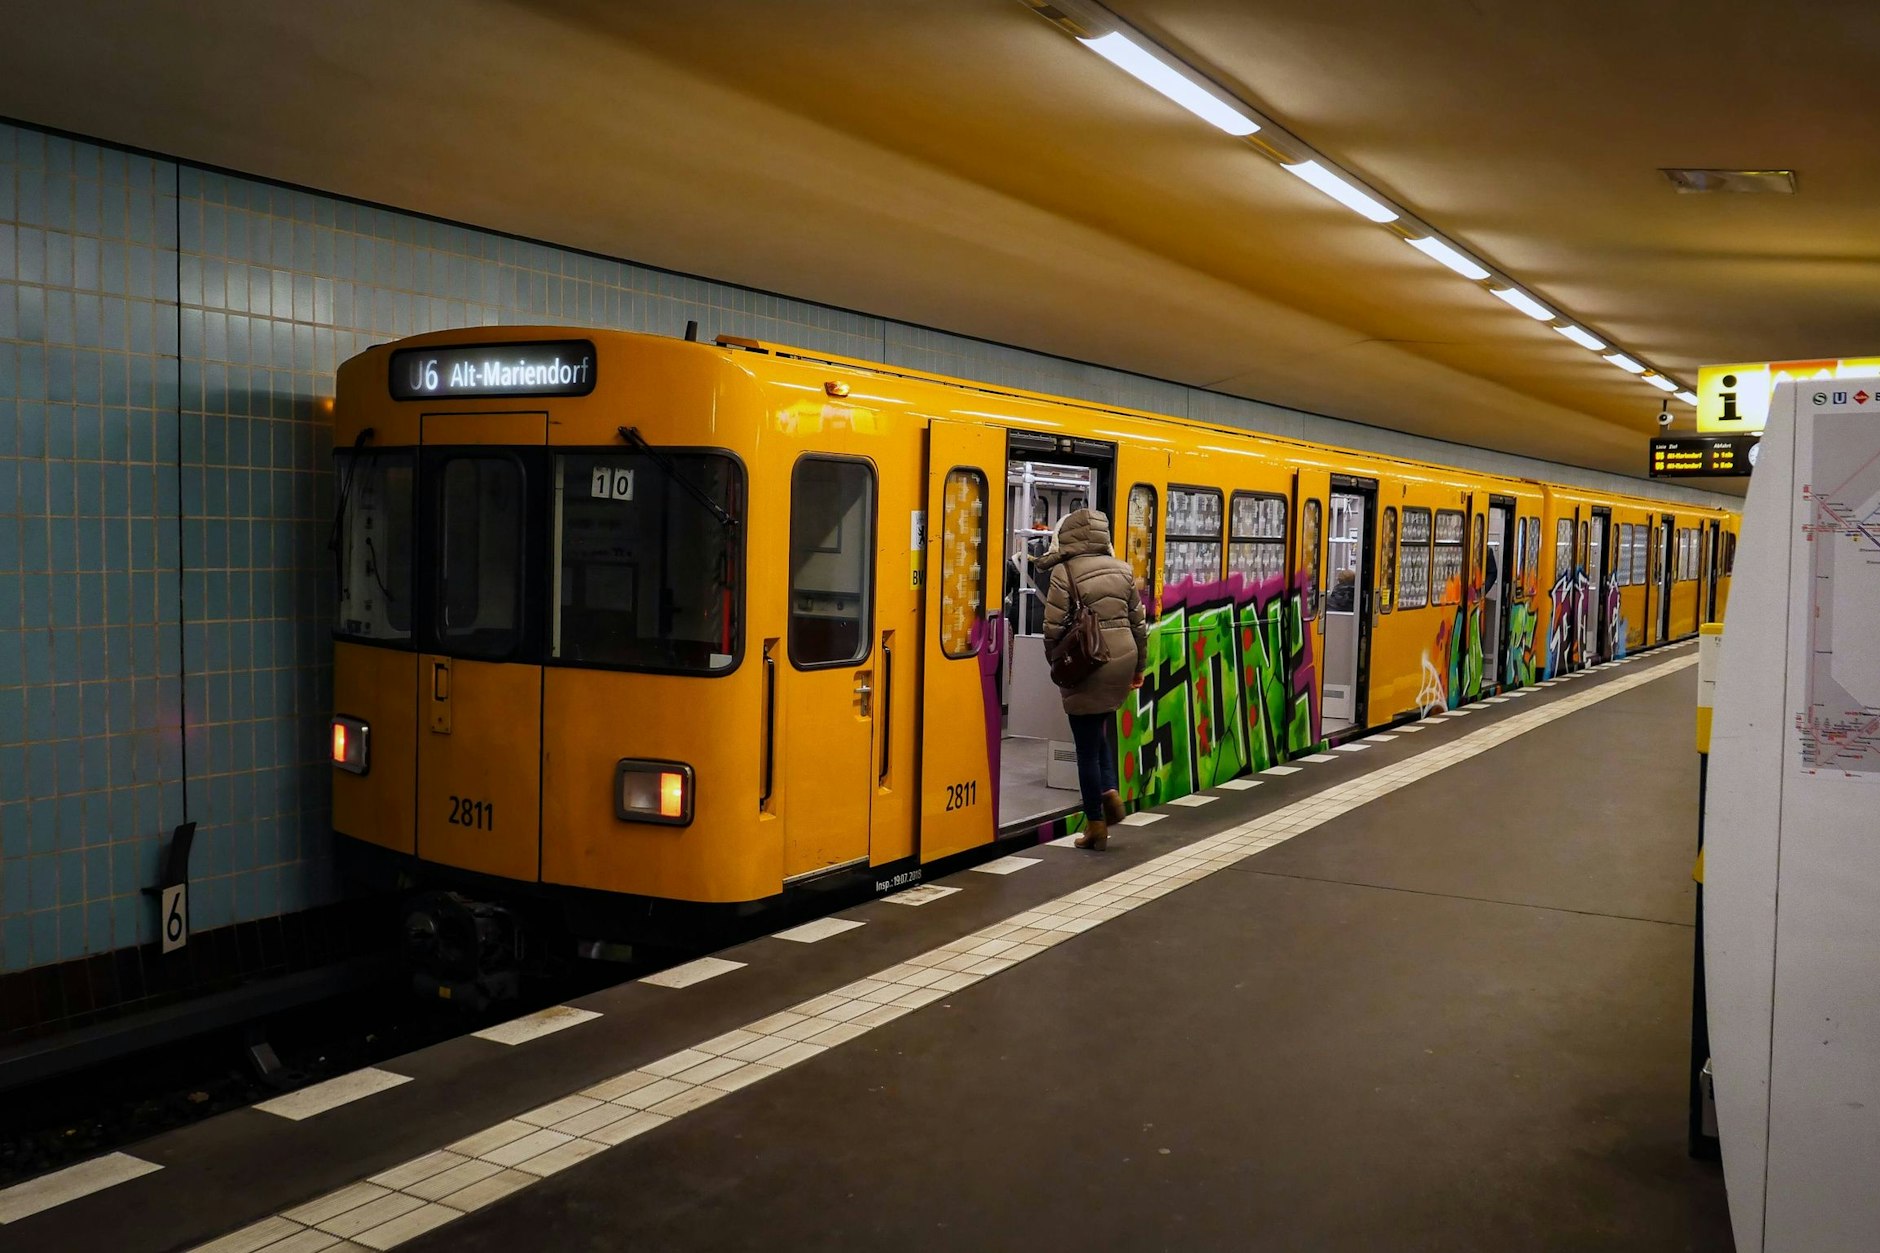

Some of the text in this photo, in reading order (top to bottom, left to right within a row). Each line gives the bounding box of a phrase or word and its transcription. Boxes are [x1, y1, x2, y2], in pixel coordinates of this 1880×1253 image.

[409, 356, 589, 391] U6 Alt-Mariendorf
[597, 474, 629, 496] 10
[912, 570, 925, 586] BV
[946, 780, 977, 812] 2811
[448, 796, 494, 831] 2811
[166, 892, 183, 942] 6
